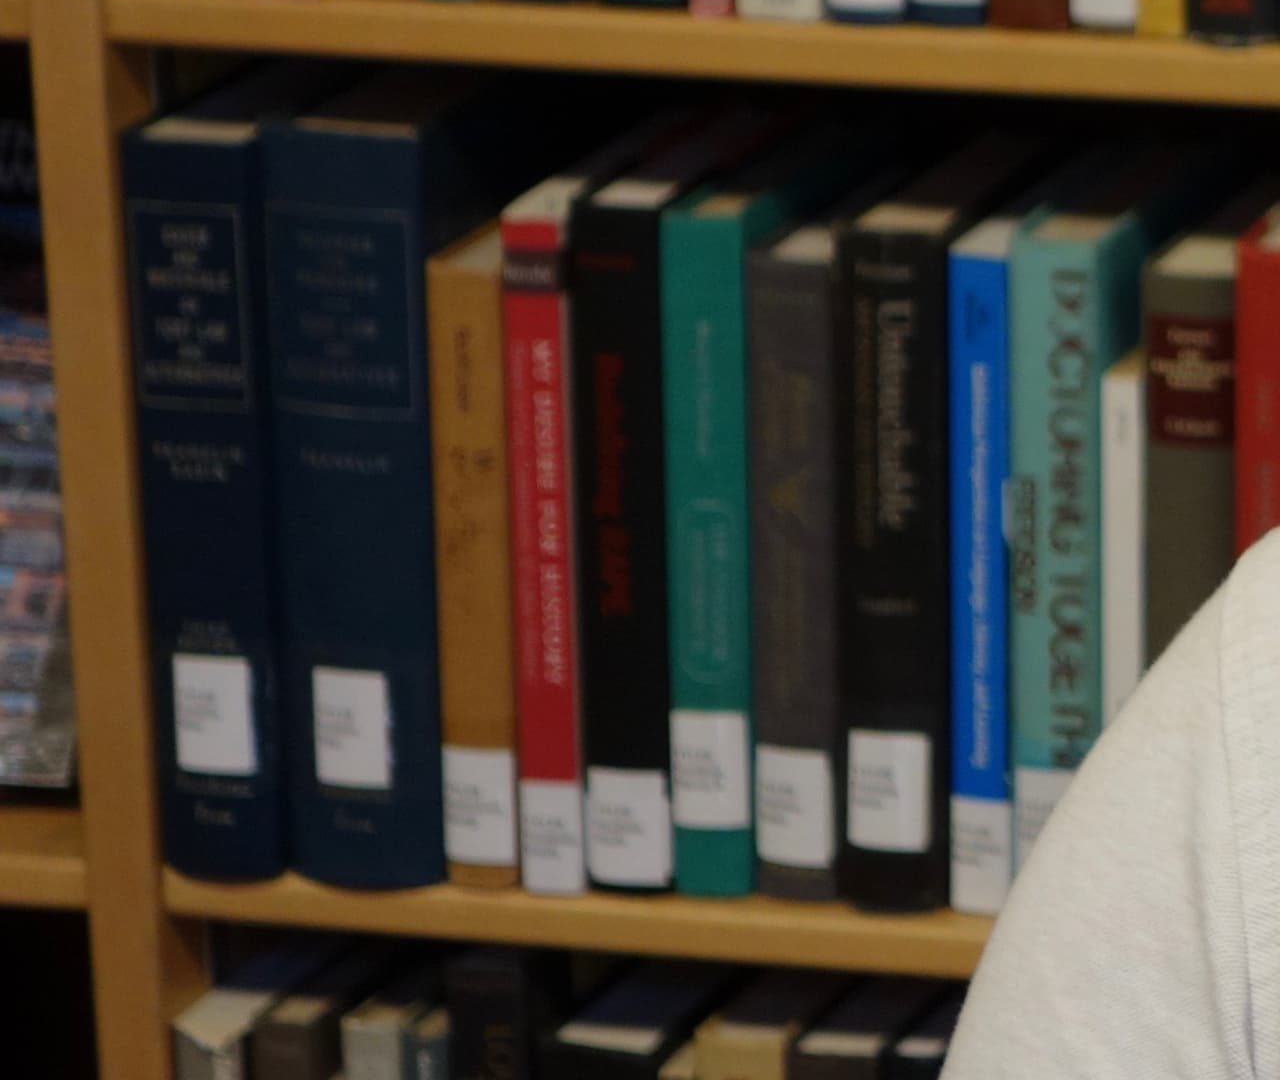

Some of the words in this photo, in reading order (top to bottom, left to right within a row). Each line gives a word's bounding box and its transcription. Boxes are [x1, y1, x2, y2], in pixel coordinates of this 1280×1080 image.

[876, 298, 919, 530] Untouchable
[1046, 267, 1092, 555] DOCTORING
[1046, 569, 1091, 767] TOGETH
